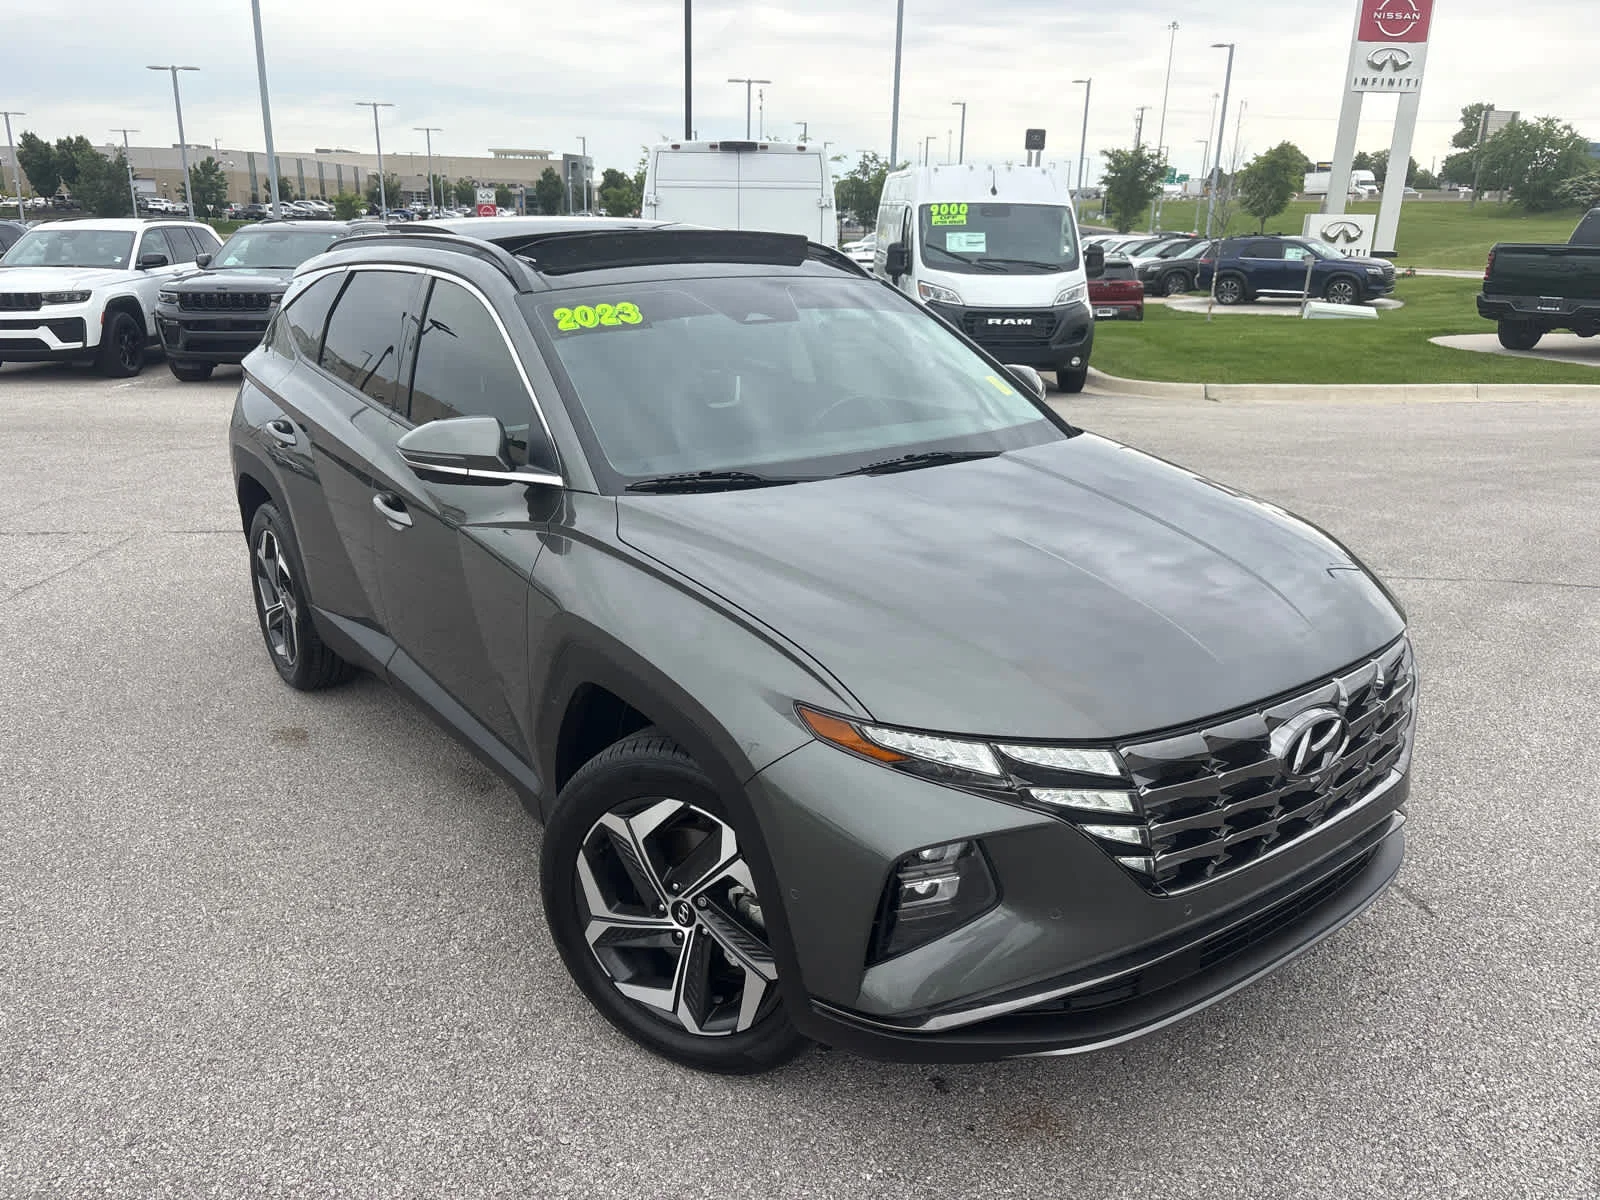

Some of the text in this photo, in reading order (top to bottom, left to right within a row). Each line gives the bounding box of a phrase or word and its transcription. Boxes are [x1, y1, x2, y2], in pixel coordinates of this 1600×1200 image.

[1373, 12, 1420, 20] NISSAN
[1353, 77, 1419, 87] INFINITI
[930, 203, 968, 216] 9000
[553, 302, 643, 331] 2023
